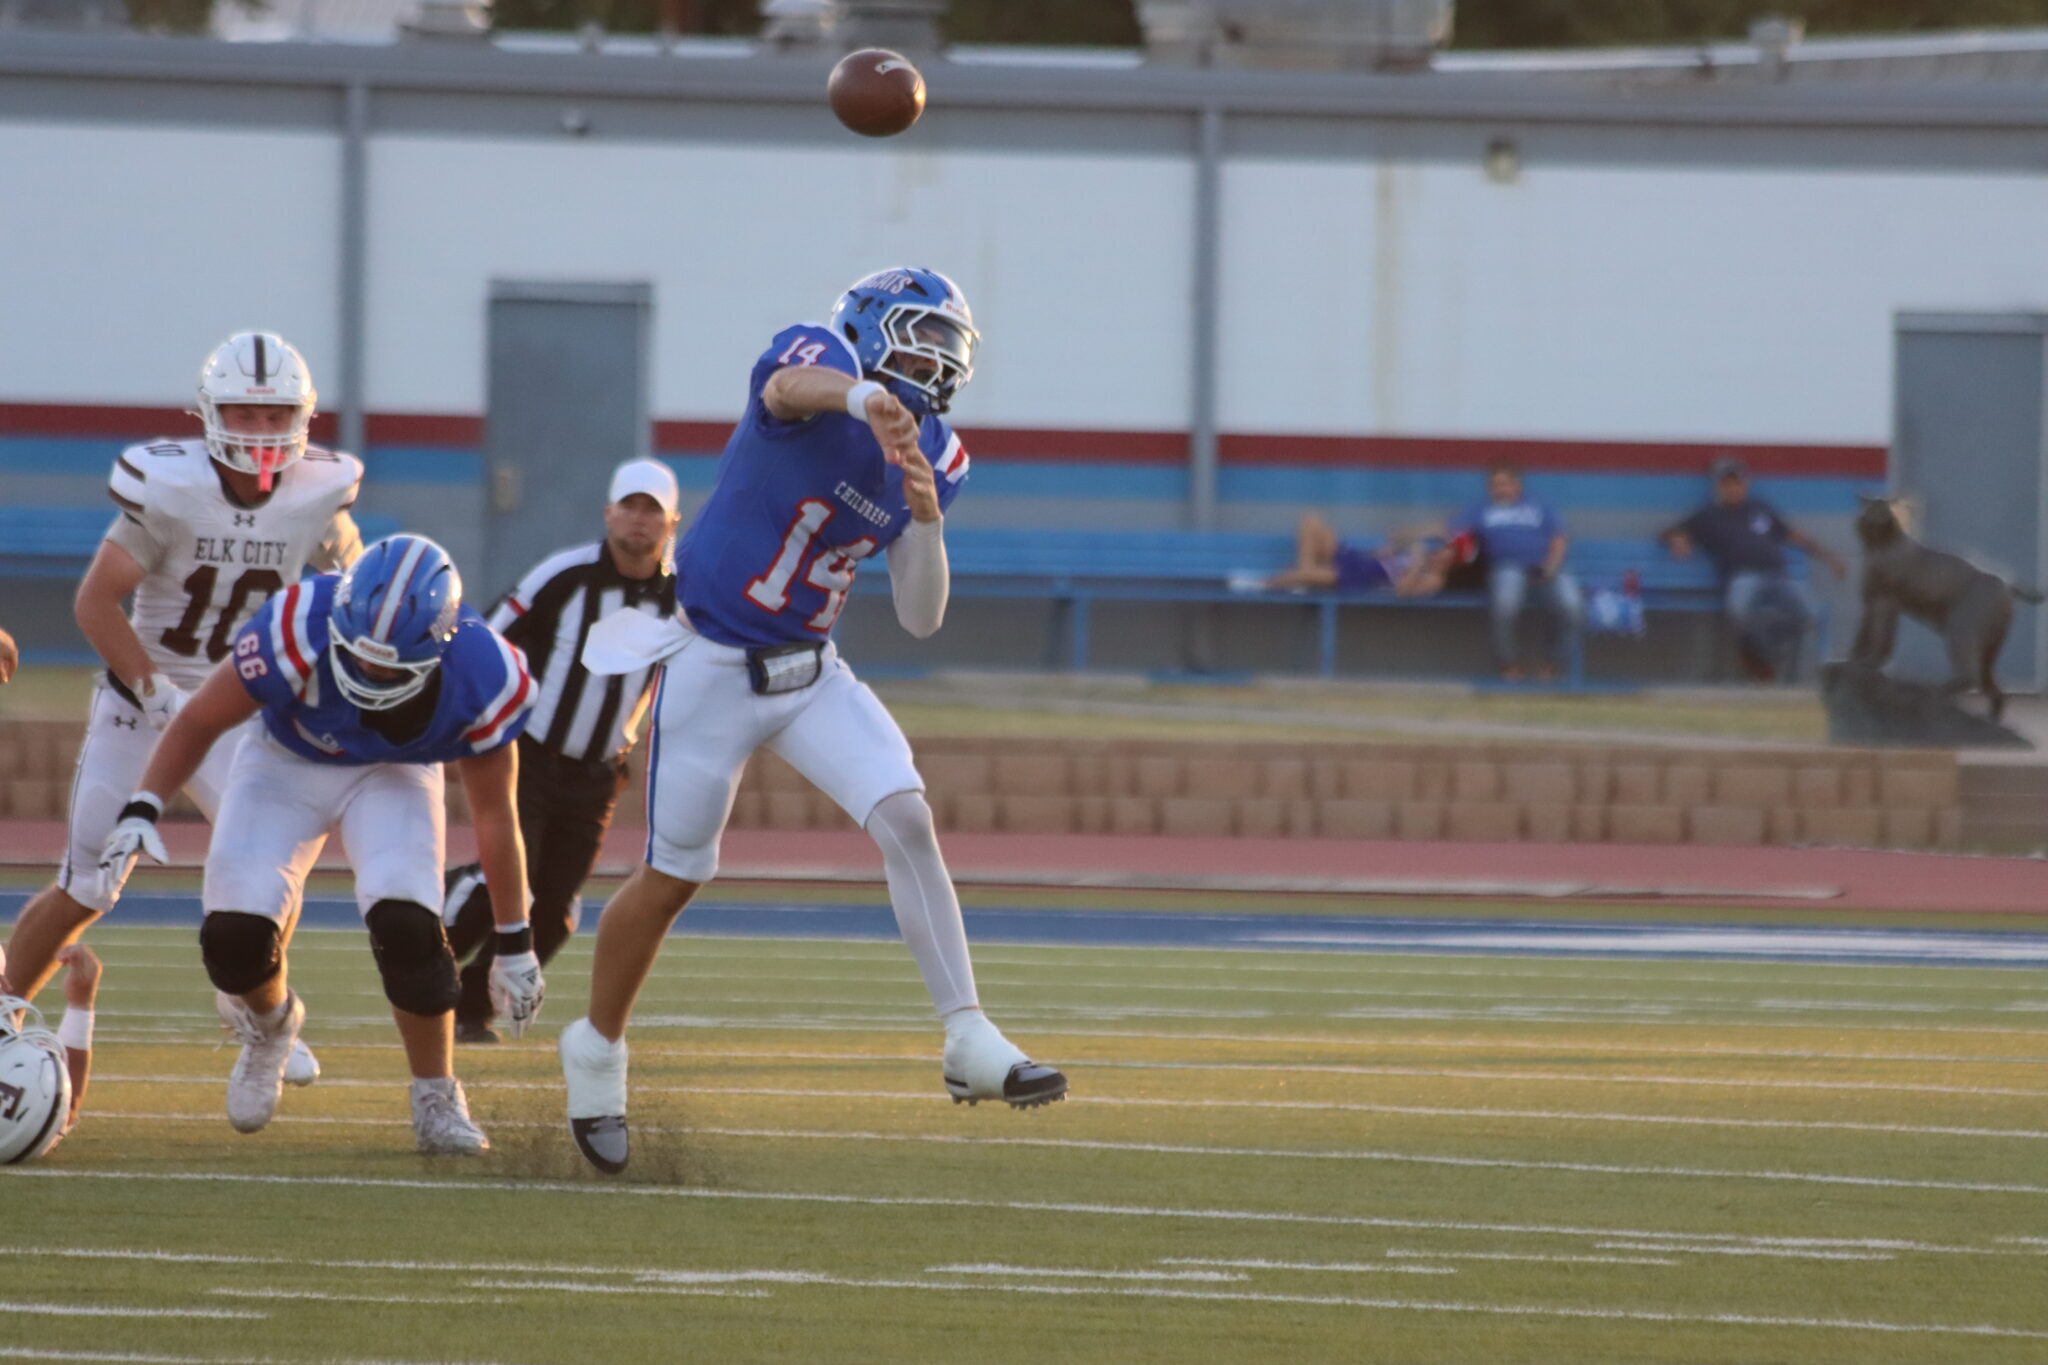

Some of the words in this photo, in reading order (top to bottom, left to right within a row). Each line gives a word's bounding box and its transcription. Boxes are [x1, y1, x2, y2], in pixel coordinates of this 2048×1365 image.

[778, 334, 829, 367] 14
[833, 481, 892, 528] CHILDRESS
[194, 538, 238, 563] ELK
[242, 540, 287, 565] CITY
[743, 498, 879, 632] 14
[160, 565, 284, 664] 10
[237, 631, 269, 681] 66
